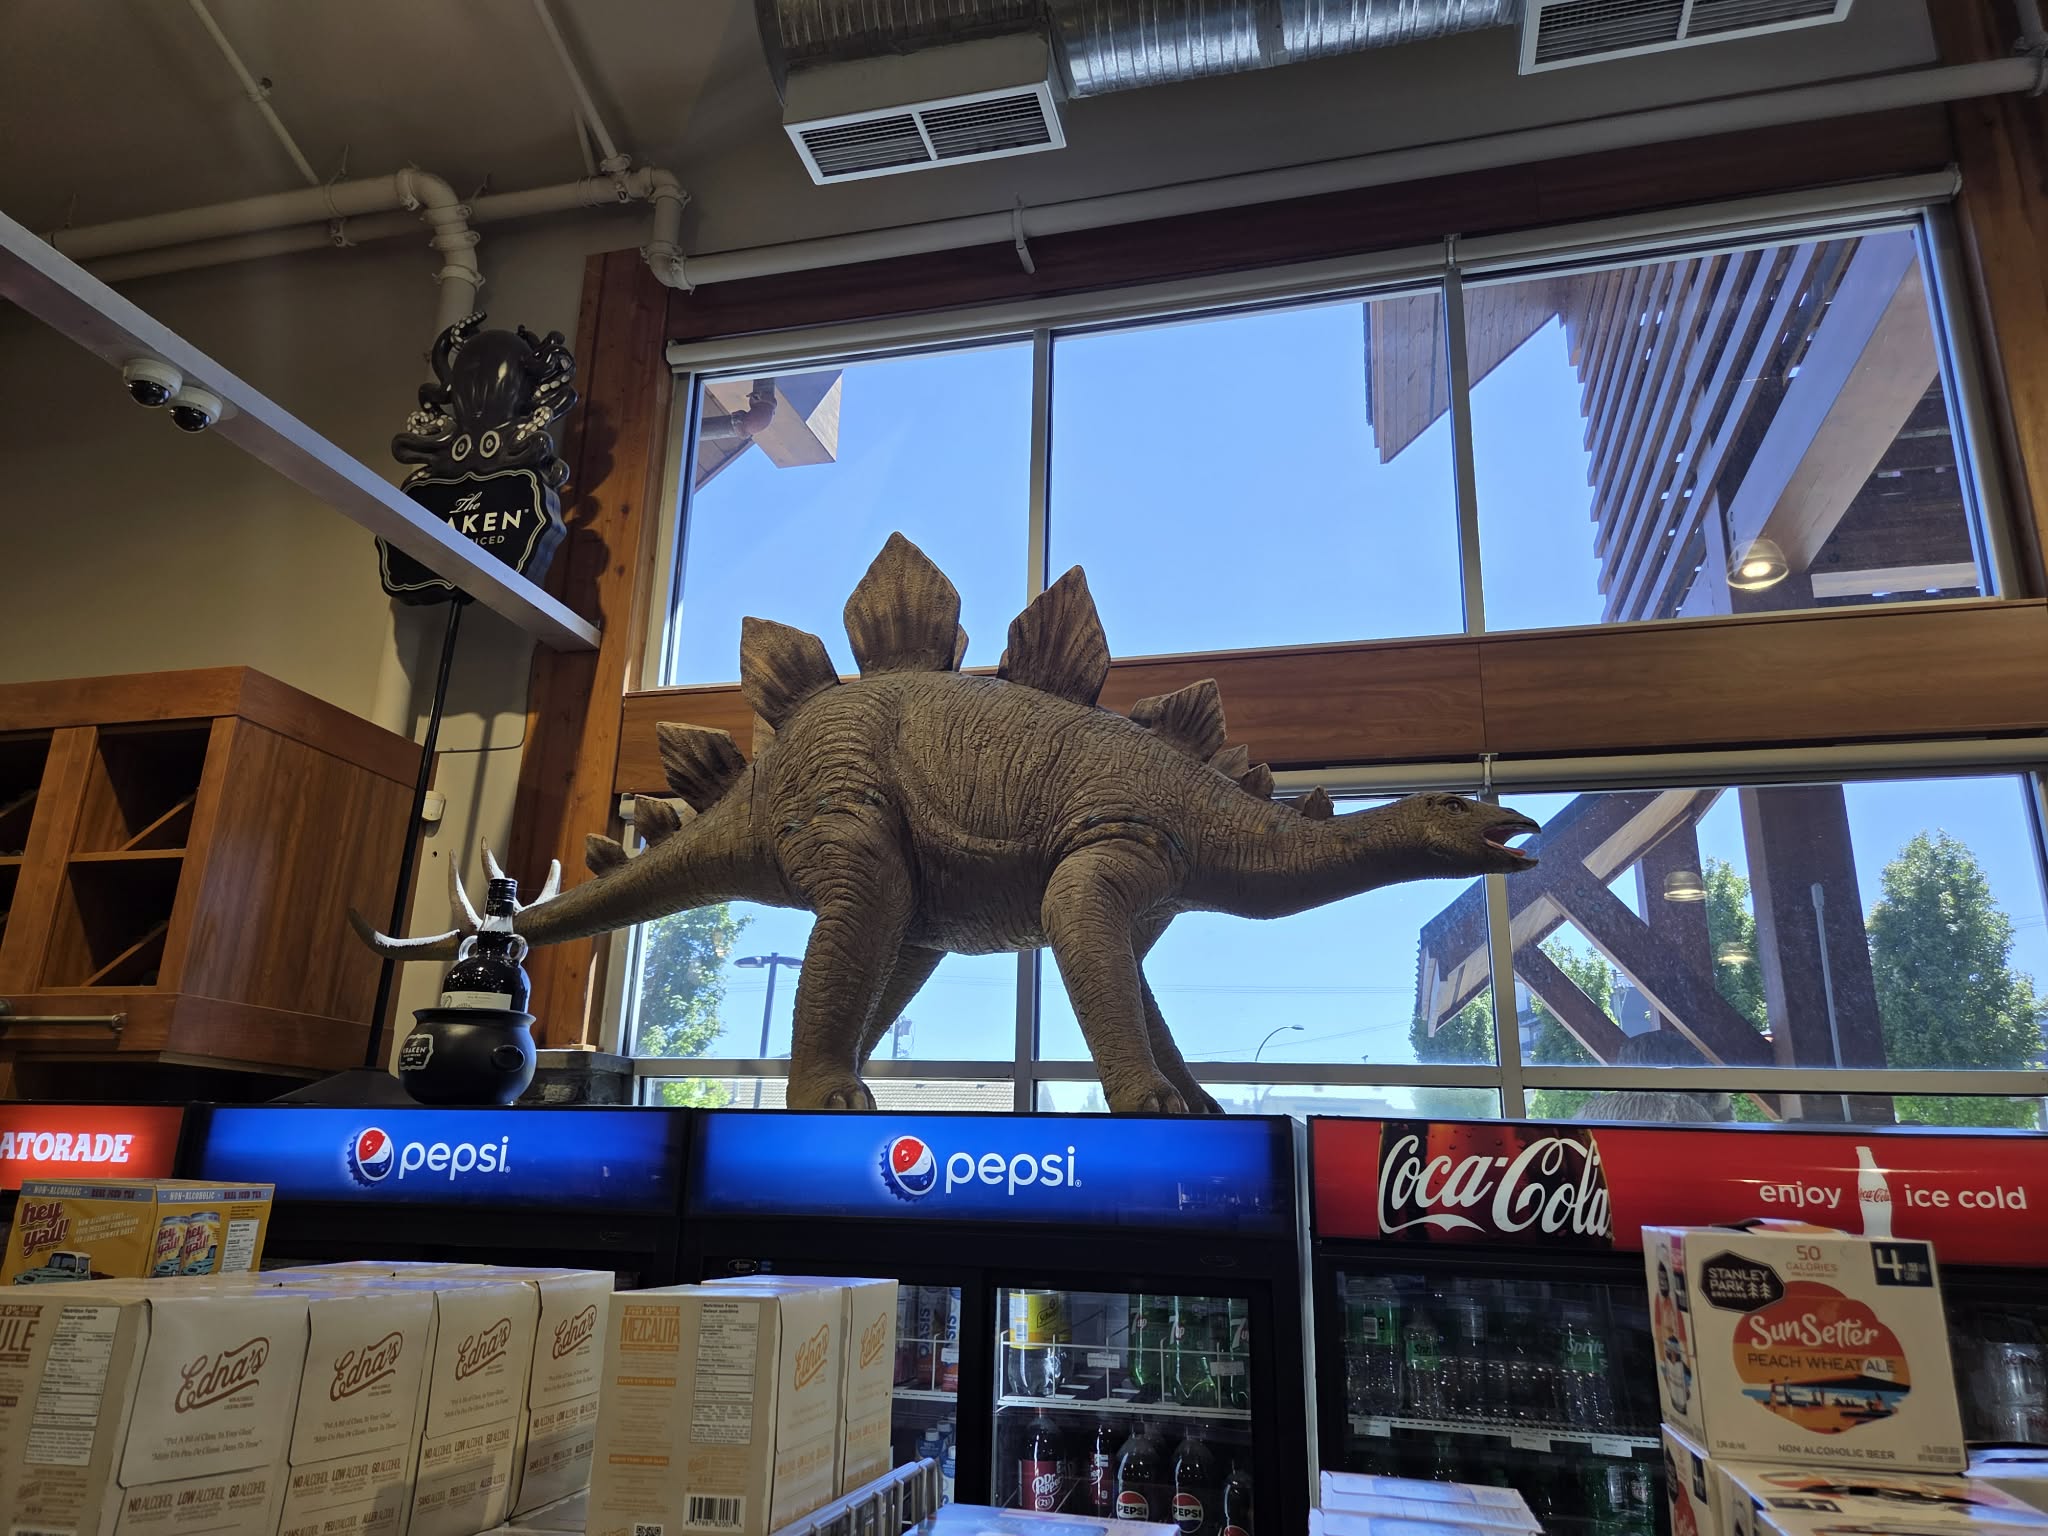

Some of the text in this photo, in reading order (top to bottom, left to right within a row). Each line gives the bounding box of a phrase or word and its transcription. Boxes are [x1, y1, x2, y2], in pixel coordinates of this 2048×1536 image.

[449, 491, 483, 514] The
[447, 509, 522, 534] AKEN
[474, 535, 505, 545] ICED
[0, 1131, 133, 1163] ATORADE
[398, 1135, 510, 1181] pepsi
[945, 1145, 1077, 1196] pepsi
[32, 1185, 82, 1197] NON-ALCOHOLIC
[169, 1191, 215, 1200] NON-ALCOHOLIC
[1378, 1134, 1611, 1237] Coca-Cola
[1759, 1180, 1842, 1209] enjoy
[1904, 1183, 2028, 1210] ice cold
[20, 1201, 63, 1228] hey
[1796, 1245, 1821, 1261] 50
[1875, 1248, 1903, 1281] 4
[1708, 1267, 1770, 1281] STANLEY
[1786, 1262, 1838, 1273] CALORIES
[1709, 1280, 1745, 1292] PARK
[1711, 1291, 1748, 1300] BREWING
[0, 1319, 39, 1352] ULE
[552, 1304, 598, 1361] Edna's
[620, 1317, 681, 1344] MEZCALITA
[1230, 1318, 1249, 1348] 7U
[1750, 1313, 1879, 1350] SunSetter
[455, 1317, 512, 1381] Edna's
[175, 1336, 270, 1414] Edna's
[330, 1331, 404, 1402] Edna's
[1748, 1353, 1897, 1373] PEACH WHEAT ALE
[431, 1443, 452, 1458] ALCOHOL
[466, 1435, 484, 1449] ALCOHOL
[493, 1429, 510, 1442] ALCOHOL
[1778, 1443, 1896, 1460] NON ALCOHOLIC BEER
[293, 1476, 304, 1489] NO
[303, 1471, 328, 1487] ALCOHOL
[332, 1468, 346, 1481] LOW
[346, 1464, 369, 1479] ALCOHOL
[380, 1458, 401, 1472] ALCOHOL
[1043, 1473, 1056, 1484] Dr
[128, 1480, 267, 1513] NO ALCOHOL LOW ALCOHOL GO ALCOHOL
[1118, 1503, 1147, 1517] PEPSI
[1173, 1506, 1202, 1519] PEPSI
